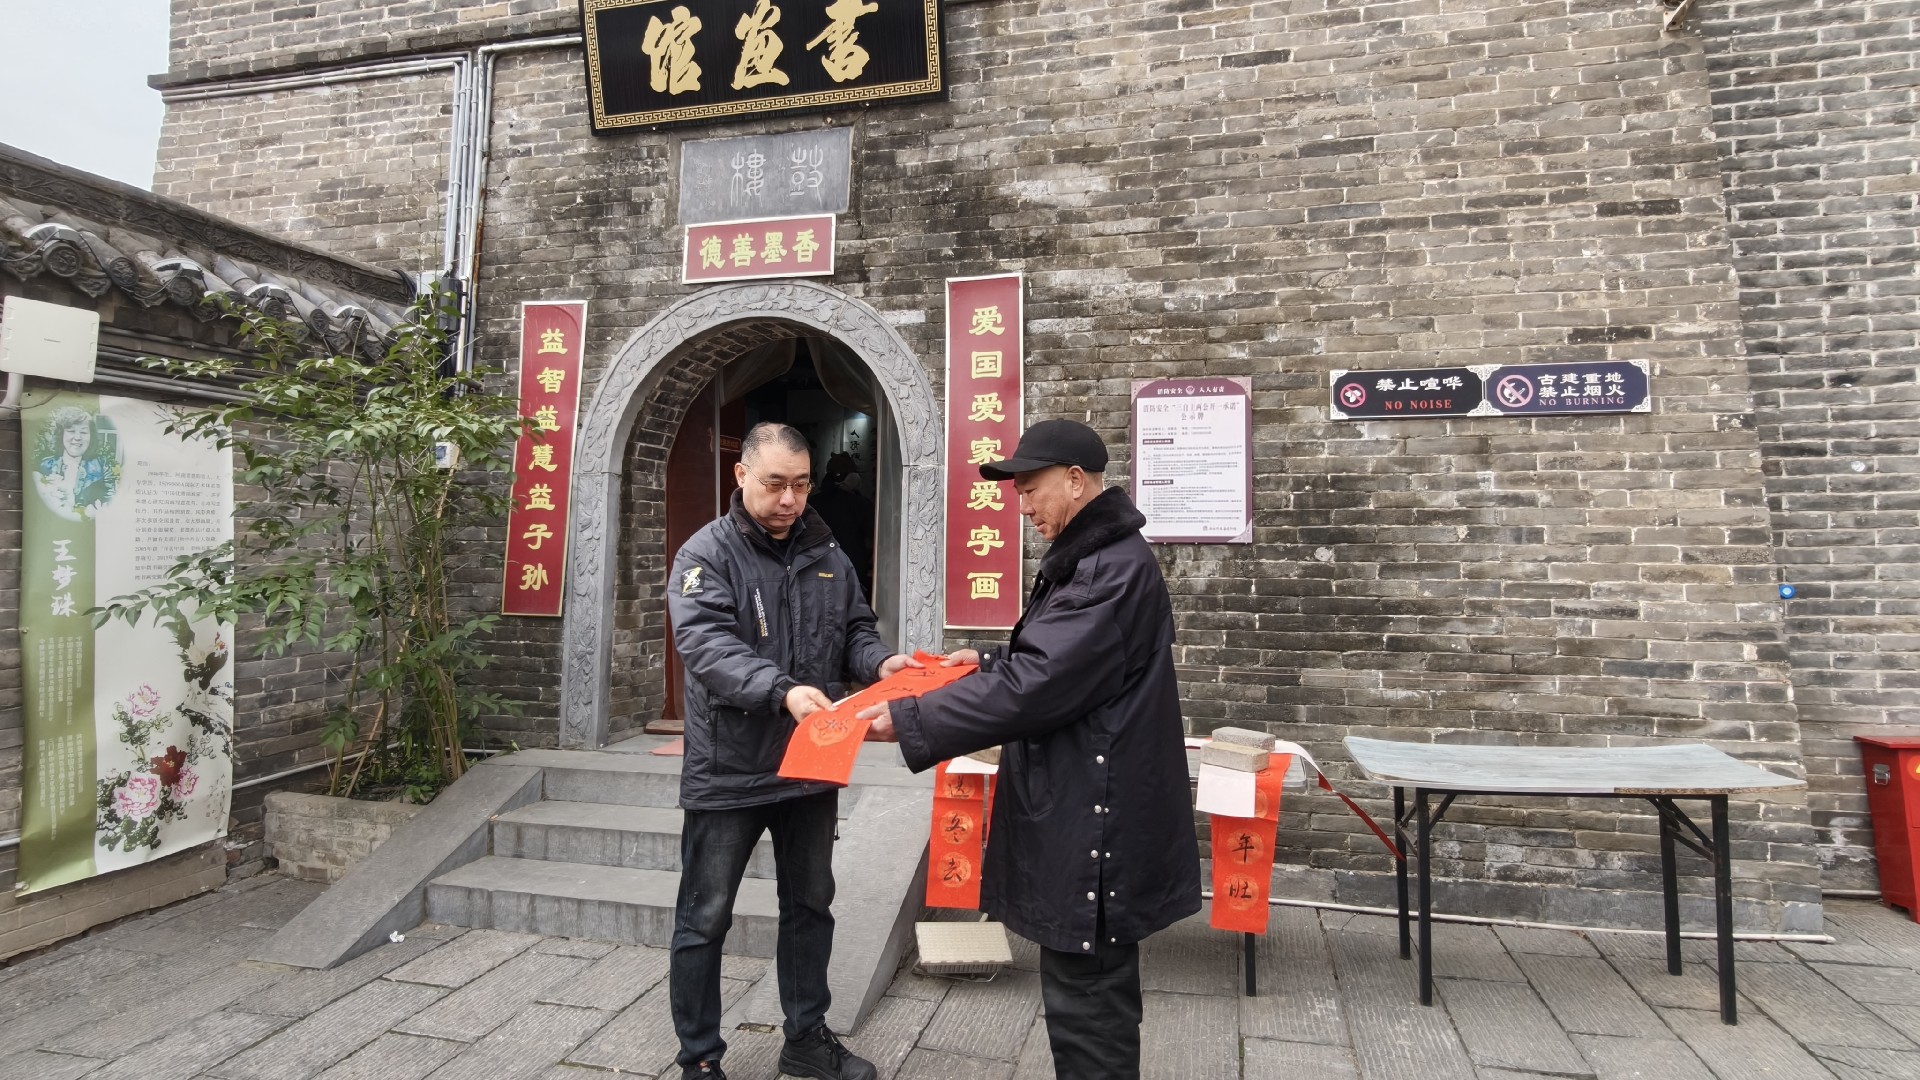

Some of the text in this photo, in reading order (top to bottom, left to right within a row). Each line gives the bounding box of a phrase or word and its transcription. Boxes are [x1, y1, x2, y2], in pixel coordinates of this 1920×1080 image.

[1375, 376, 1463, 392] 禁止喧哗
[1537, 372, 1625, 386] 古建重地
[1537, 384, 1626, 398] 禁止烟火
[1384, 398, 1452, 411] NO NOISE
[1539, 396, 1625, 406] NO BURNING
[518, 328, 568, 591] 益智益慧益子孙
[965, 305, 1005, 600] 爱国爱家爱字画
